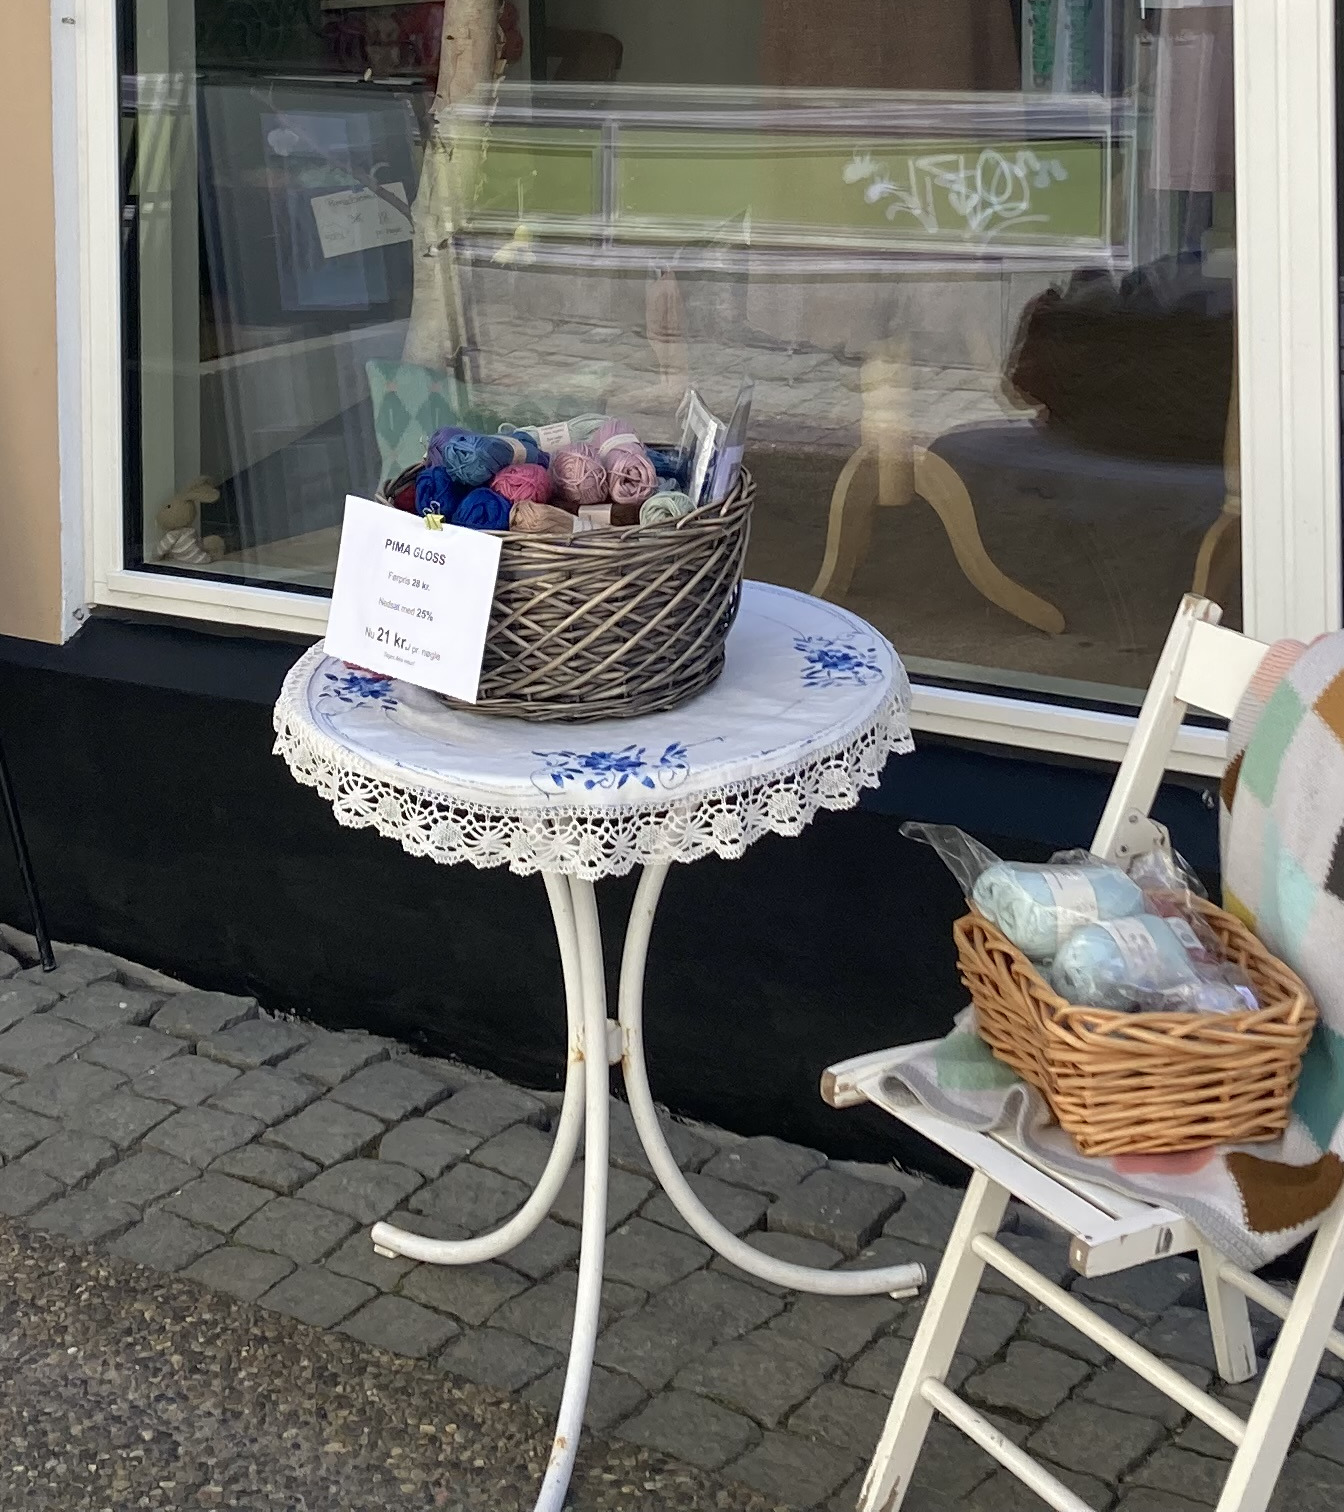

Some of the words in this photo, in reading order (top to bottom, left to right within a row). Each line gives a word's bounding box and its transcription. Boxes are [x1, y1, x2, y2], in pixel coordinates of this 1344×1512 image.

[385, 538, 411, 556] PIMA
[413, 547, 446, 565] GLOSS
[401, 606, 415, 616] med
[416, 608, 433, 622] 25%
[365, 626, 375, 639] Nu
[376, 627, 390, 644] 21
